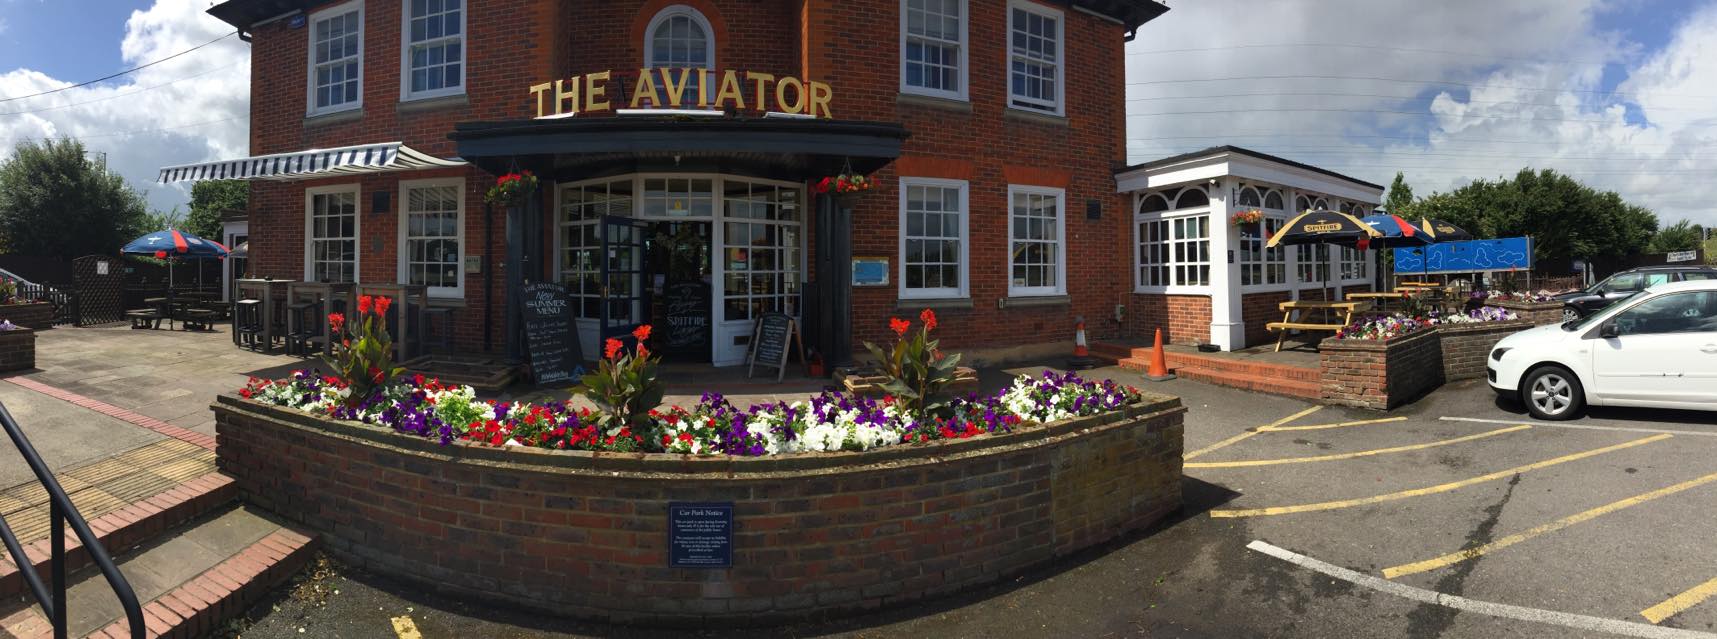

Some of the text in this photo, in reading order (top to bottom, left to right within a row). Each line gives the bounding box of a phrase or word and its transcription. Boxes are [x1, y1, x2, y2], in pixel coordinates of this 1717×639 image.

[529, 66, 834, 120] THE AVIATOR
[525, 299, 568, 308] SUMMER
[536, 307, 561, 315] MENU
